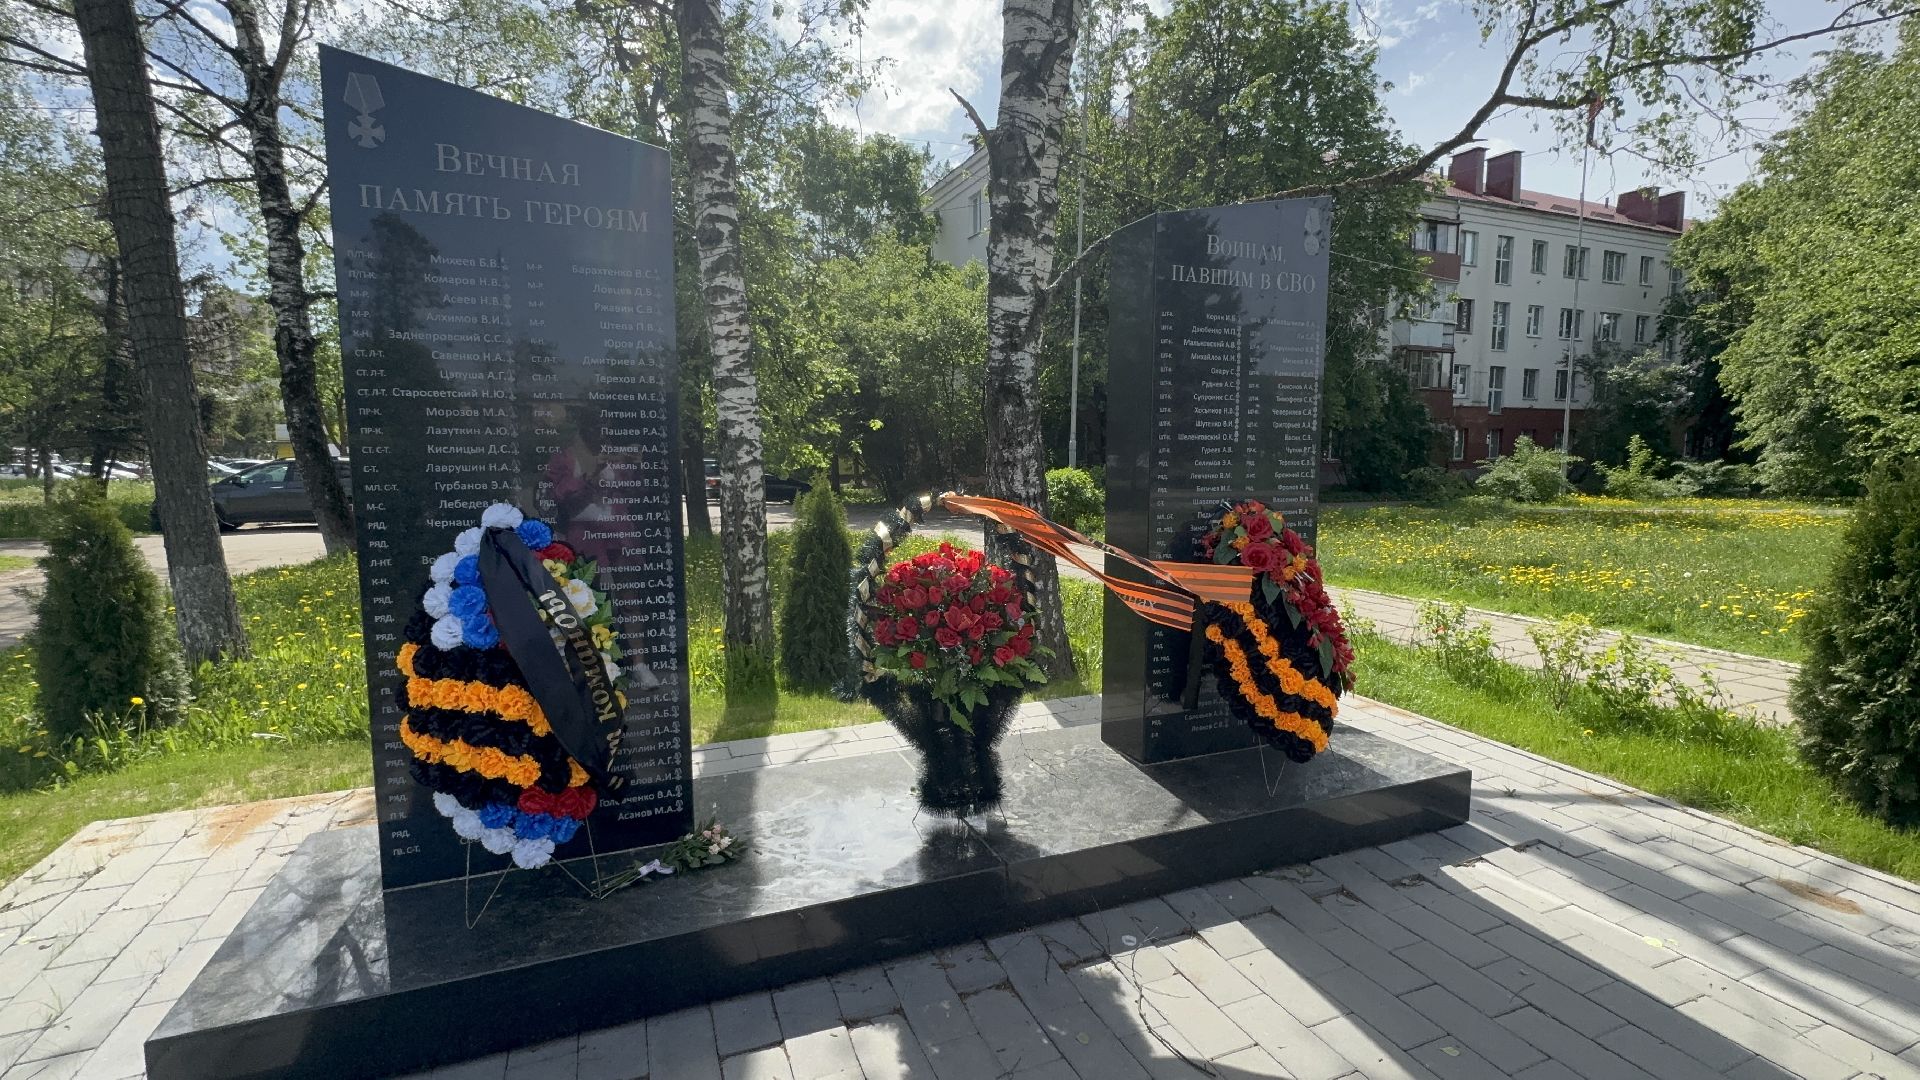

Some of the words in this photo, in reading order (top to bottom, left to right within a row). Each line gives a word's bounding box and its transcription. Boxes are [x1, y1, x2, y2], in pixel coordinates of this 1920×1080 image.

[360, 184, 510, 220] ПАМЯТЬ
[526, 200, 648, 232] ГЕРОЯМ
[430, 255, 475, 266] Михеев
[480, 258, 501, 268] Б.В.
[572, 265, 632, 276] Барахтенко
[424, 274, 475, 285] Комаров
[480, 278, 500, 286] Н.В.
[1172, 264, 1253, 288] ПАВШИМ
[1277, 272, 1316, 293] СВО
[593, 284, 631, 294] Ловцев
[443, 294, 476, 304] Асеев
[480, 296, 499, 305] Н.В.
[594, 303, 633, 312] Ржавин
[426, 313, 478, 323] Алхимов
[482, 315, 503, 324] В.И.
[388, 330, 480, 341] Заднепровский
[484, 334, 506, 342] С.С.
[604, 339, 633, 350] Юров
[636, 340, 658, 350] Д.А.
[432, 351, 480, 360] Савенко
[484, 353, 506, 361] Н.А.
[583, 357, 635, 366] Дмитриев
[638, 358, 657, 366] А.Э.
[440, 370, 484, 380] Цапуша
[488, 372, 508, 380] А.Г.
[596, 374, 635, 384] Терехов
[639, 376, 658, 384] А.В.
[393, 388, 477, 398] Старосветский
[482, 390, 507, 398] Н.Ю.
[590, 392, 634, 400] Моисеев
[426, 408, 478, 416] Морозов
[483, 408, 508, 416] М.А.
[600, 410, 636, 418] Литвин
[641, 410, 660, 418] В.О.
[426, 426, 480, 436] Лазуткин
[485, 427, 509, 435] А.Ю.
[428, 445, 484, 454] Кислицын
[488, 445, 510, 454] Д.С.
[601, 445, 638, 454] Храмов
[426, 464, 485, 473] Лаврушин
[435, 481, 487, 491] Гурбанов
[492, 481, 512, 489] Э.А.
[599, 480, 641, 488] Садиков
[439, 500, 490, 511] Лебедев
[646, 512, 665, 520] Л.Р.
[583, 531, 641, 539] Литвиненко
[644, 528, 666, 537] С.А.
[622, 547, 646, 556] Гусев
[650, 546, 666, 554] Г.А.
[648, 579, 668, 587] С.А.
[646, 596, 668, 604] А.Ю.
[652, 612, 670, 620] Р.В.
[648, 628, 670, 637] Ю.А.
[653, 661, 671, 669] Р.И.
[654, 694, 672, 702] К.С.
[654, 710, 673, 718] А.Б.
[653, 726, 674, 736] Д.А.
[658, 757, 675, 765] А.Г.
[656, 773, 676, 782] А.И.
[658, 790, 676, 798] В.А.
[618, 810, 652, 820] Асанов
[655, 806, 678, 814] М.А.
